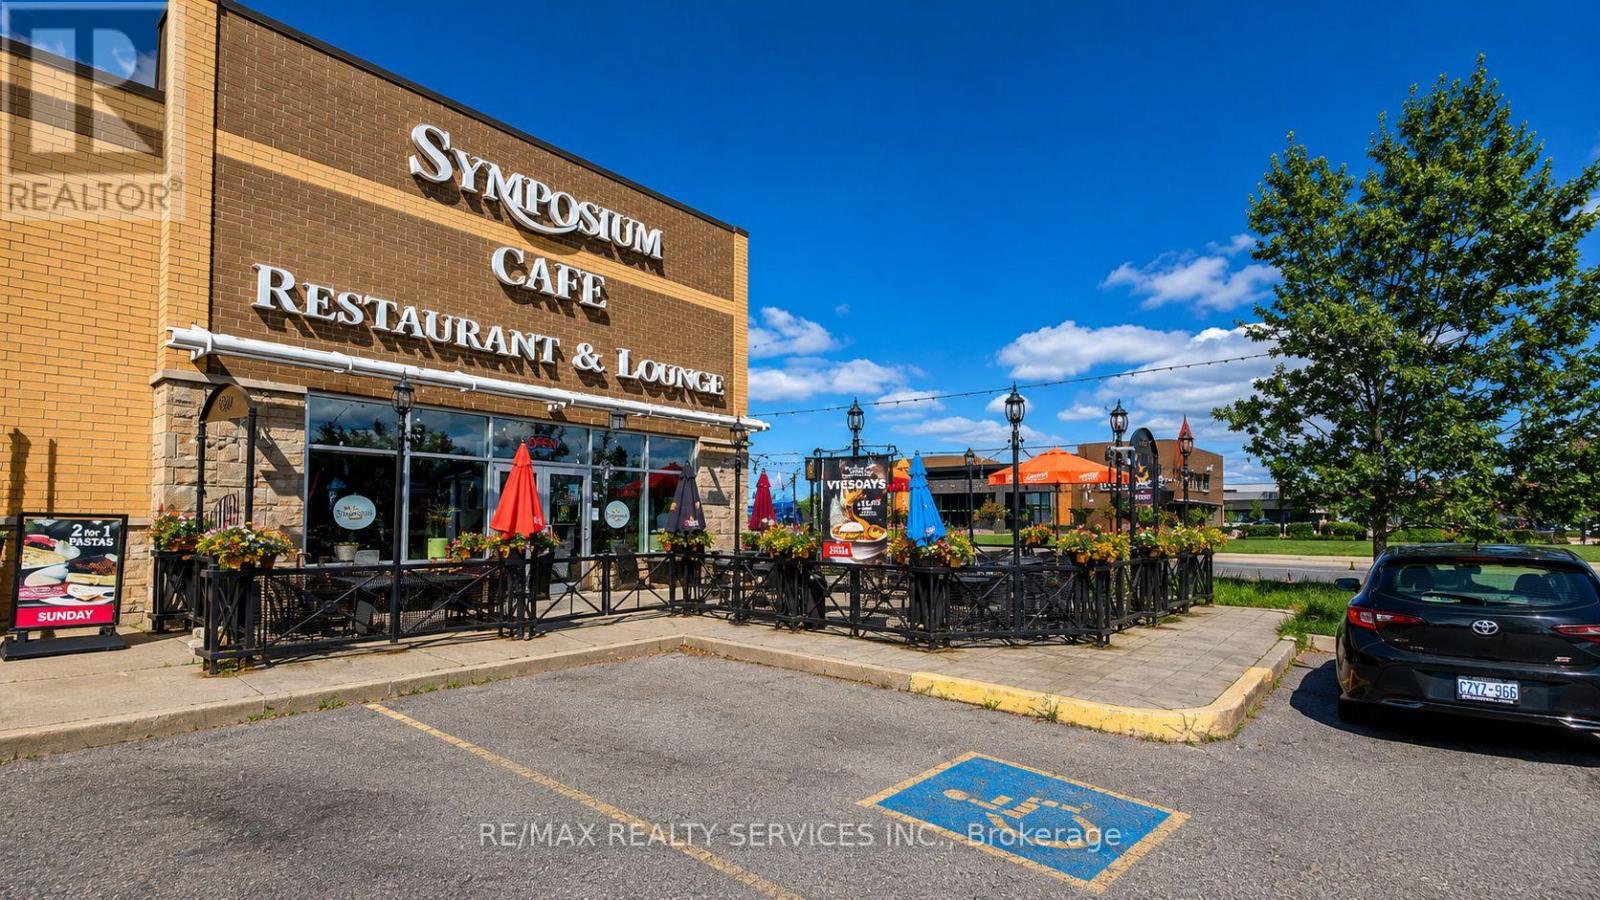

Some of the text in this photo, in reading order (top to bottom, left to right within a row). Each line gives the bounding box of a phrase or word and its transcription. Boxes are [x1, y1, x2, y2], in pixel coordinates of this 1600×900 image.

[408, 123, 664, 260] SYMPOSIUM
[491, 246, 607, 309] CAFE
[251, 262, 726, 397] RESTAURANT & LOUNGE
[71, 524, 83, 537] 2
[103, 525, 110, 537] 1
[69, 537, 114, 547] PASTAS
[37, 609, 94, 622] SUNDAY
[1459, 680, 1517, 699] CZYZ-966
